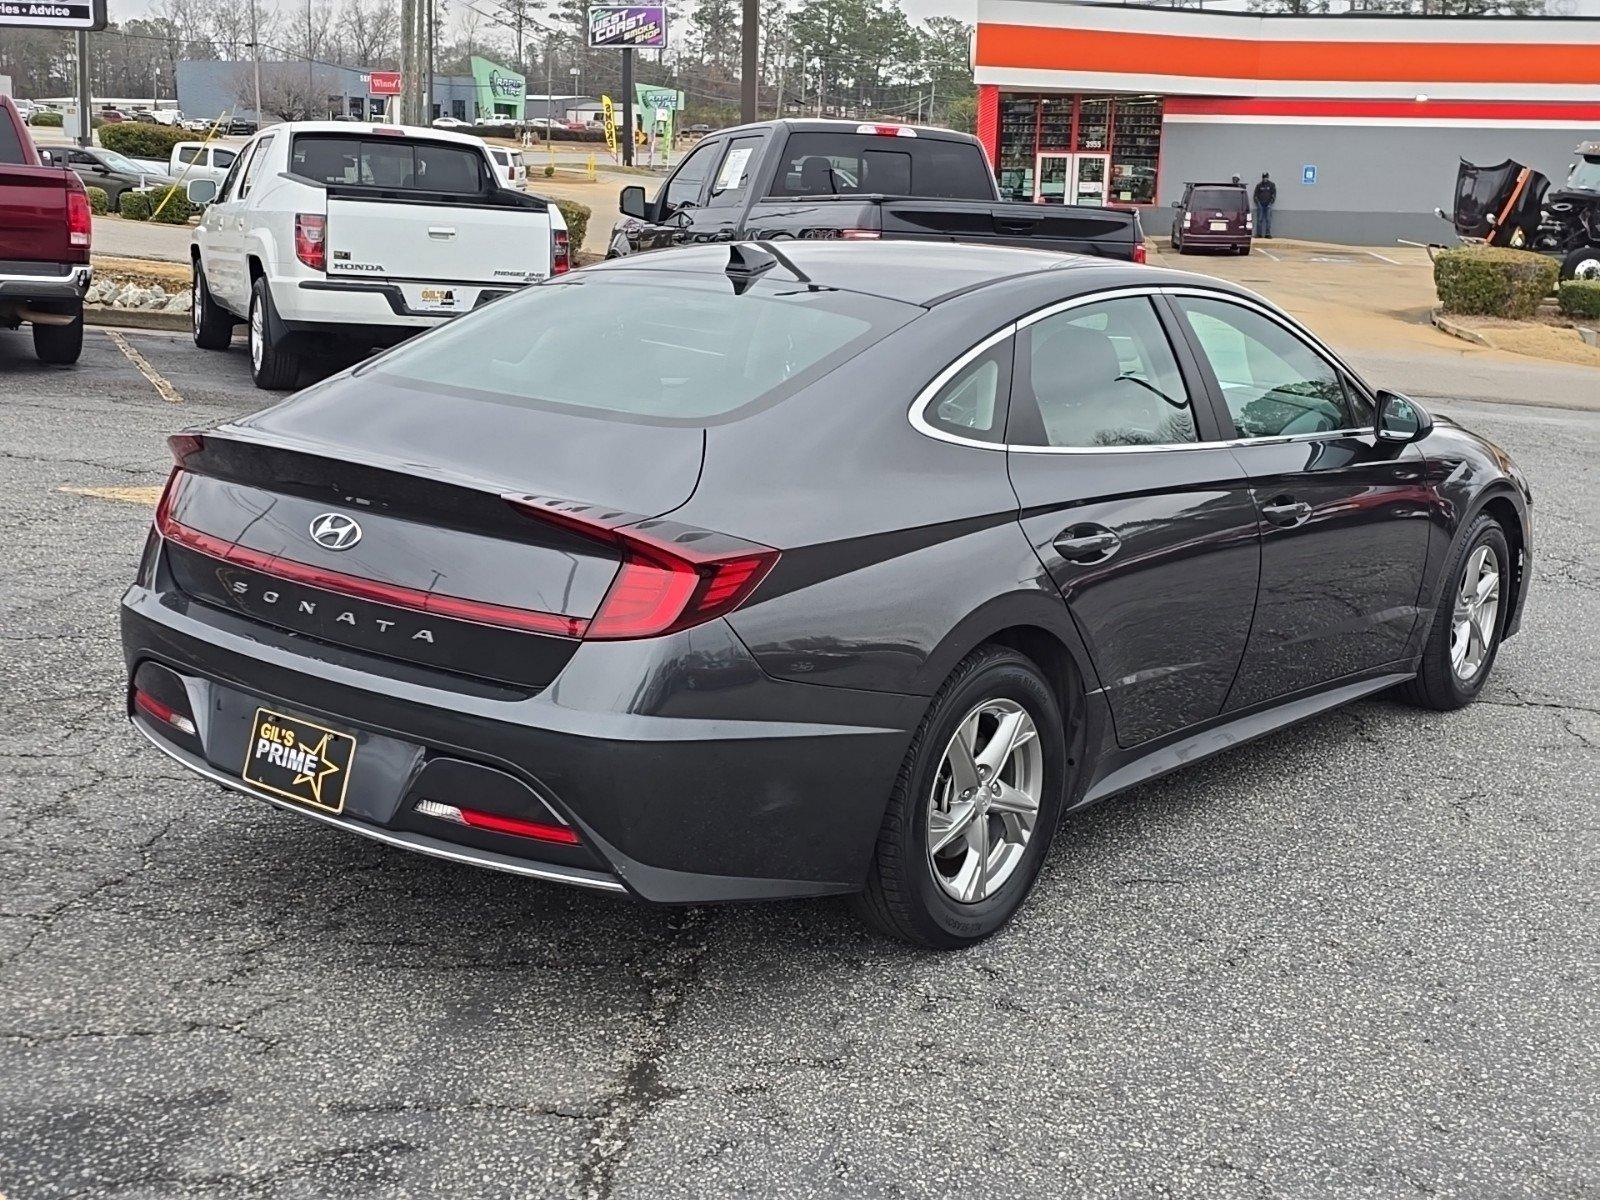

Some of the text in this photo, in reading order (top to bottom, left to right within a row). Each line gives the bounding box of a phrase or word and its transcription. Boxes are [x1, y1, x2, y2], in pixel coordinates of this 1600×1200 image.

[29, 5, 70, 16] Advice
[592, 9, 629, 32] WEST
[595, 13, 647, 42] COAST
[623, 22, 656, 40] SMOKE
[635, 28, 661, 43] SHOP
[334, 263, 386, 271] HONDA
[232, 581, 435, 644] SONATA
[260, 722, 295, 747] GIL'S
[255, 738, 319, 777] PRIME
